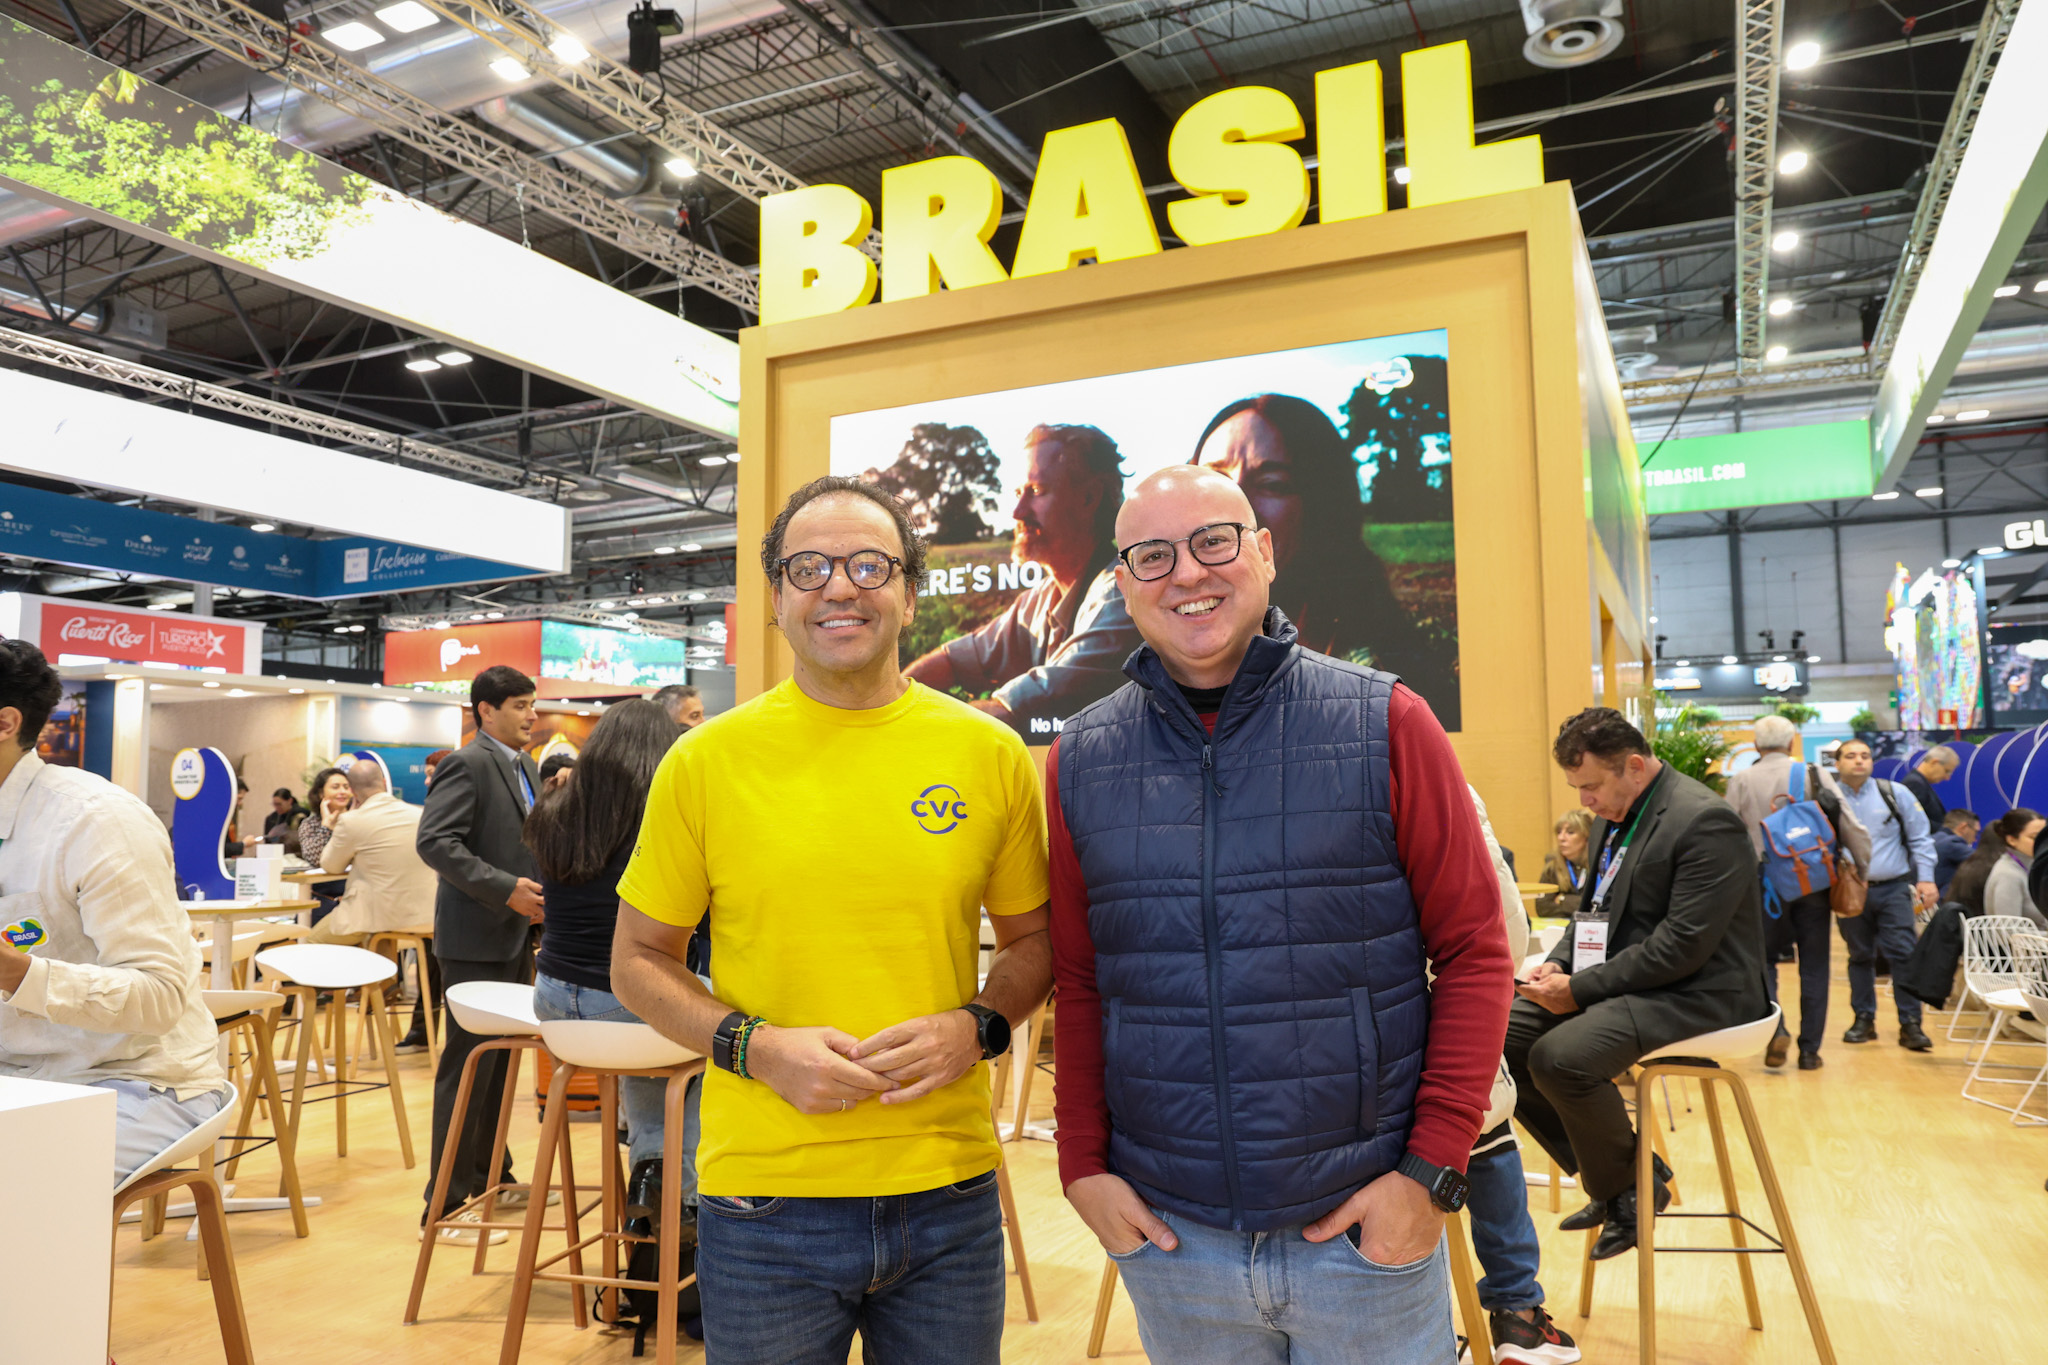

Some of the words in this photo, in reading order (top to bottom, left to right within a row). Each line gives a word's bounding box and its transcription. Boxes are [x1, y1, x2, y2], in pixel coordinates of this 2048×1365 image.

[758, 39, 1545, 327] BRASIL
[371, 546, 427, 573] Inclusive
[998, 560, 1043, 590] NO
[60, 616, 109, 642] Puerto
[108, 623, 146, 648] Rico
[1030, 717, 1051, 733] No
[12, 931, 39, 942] BRASIL
